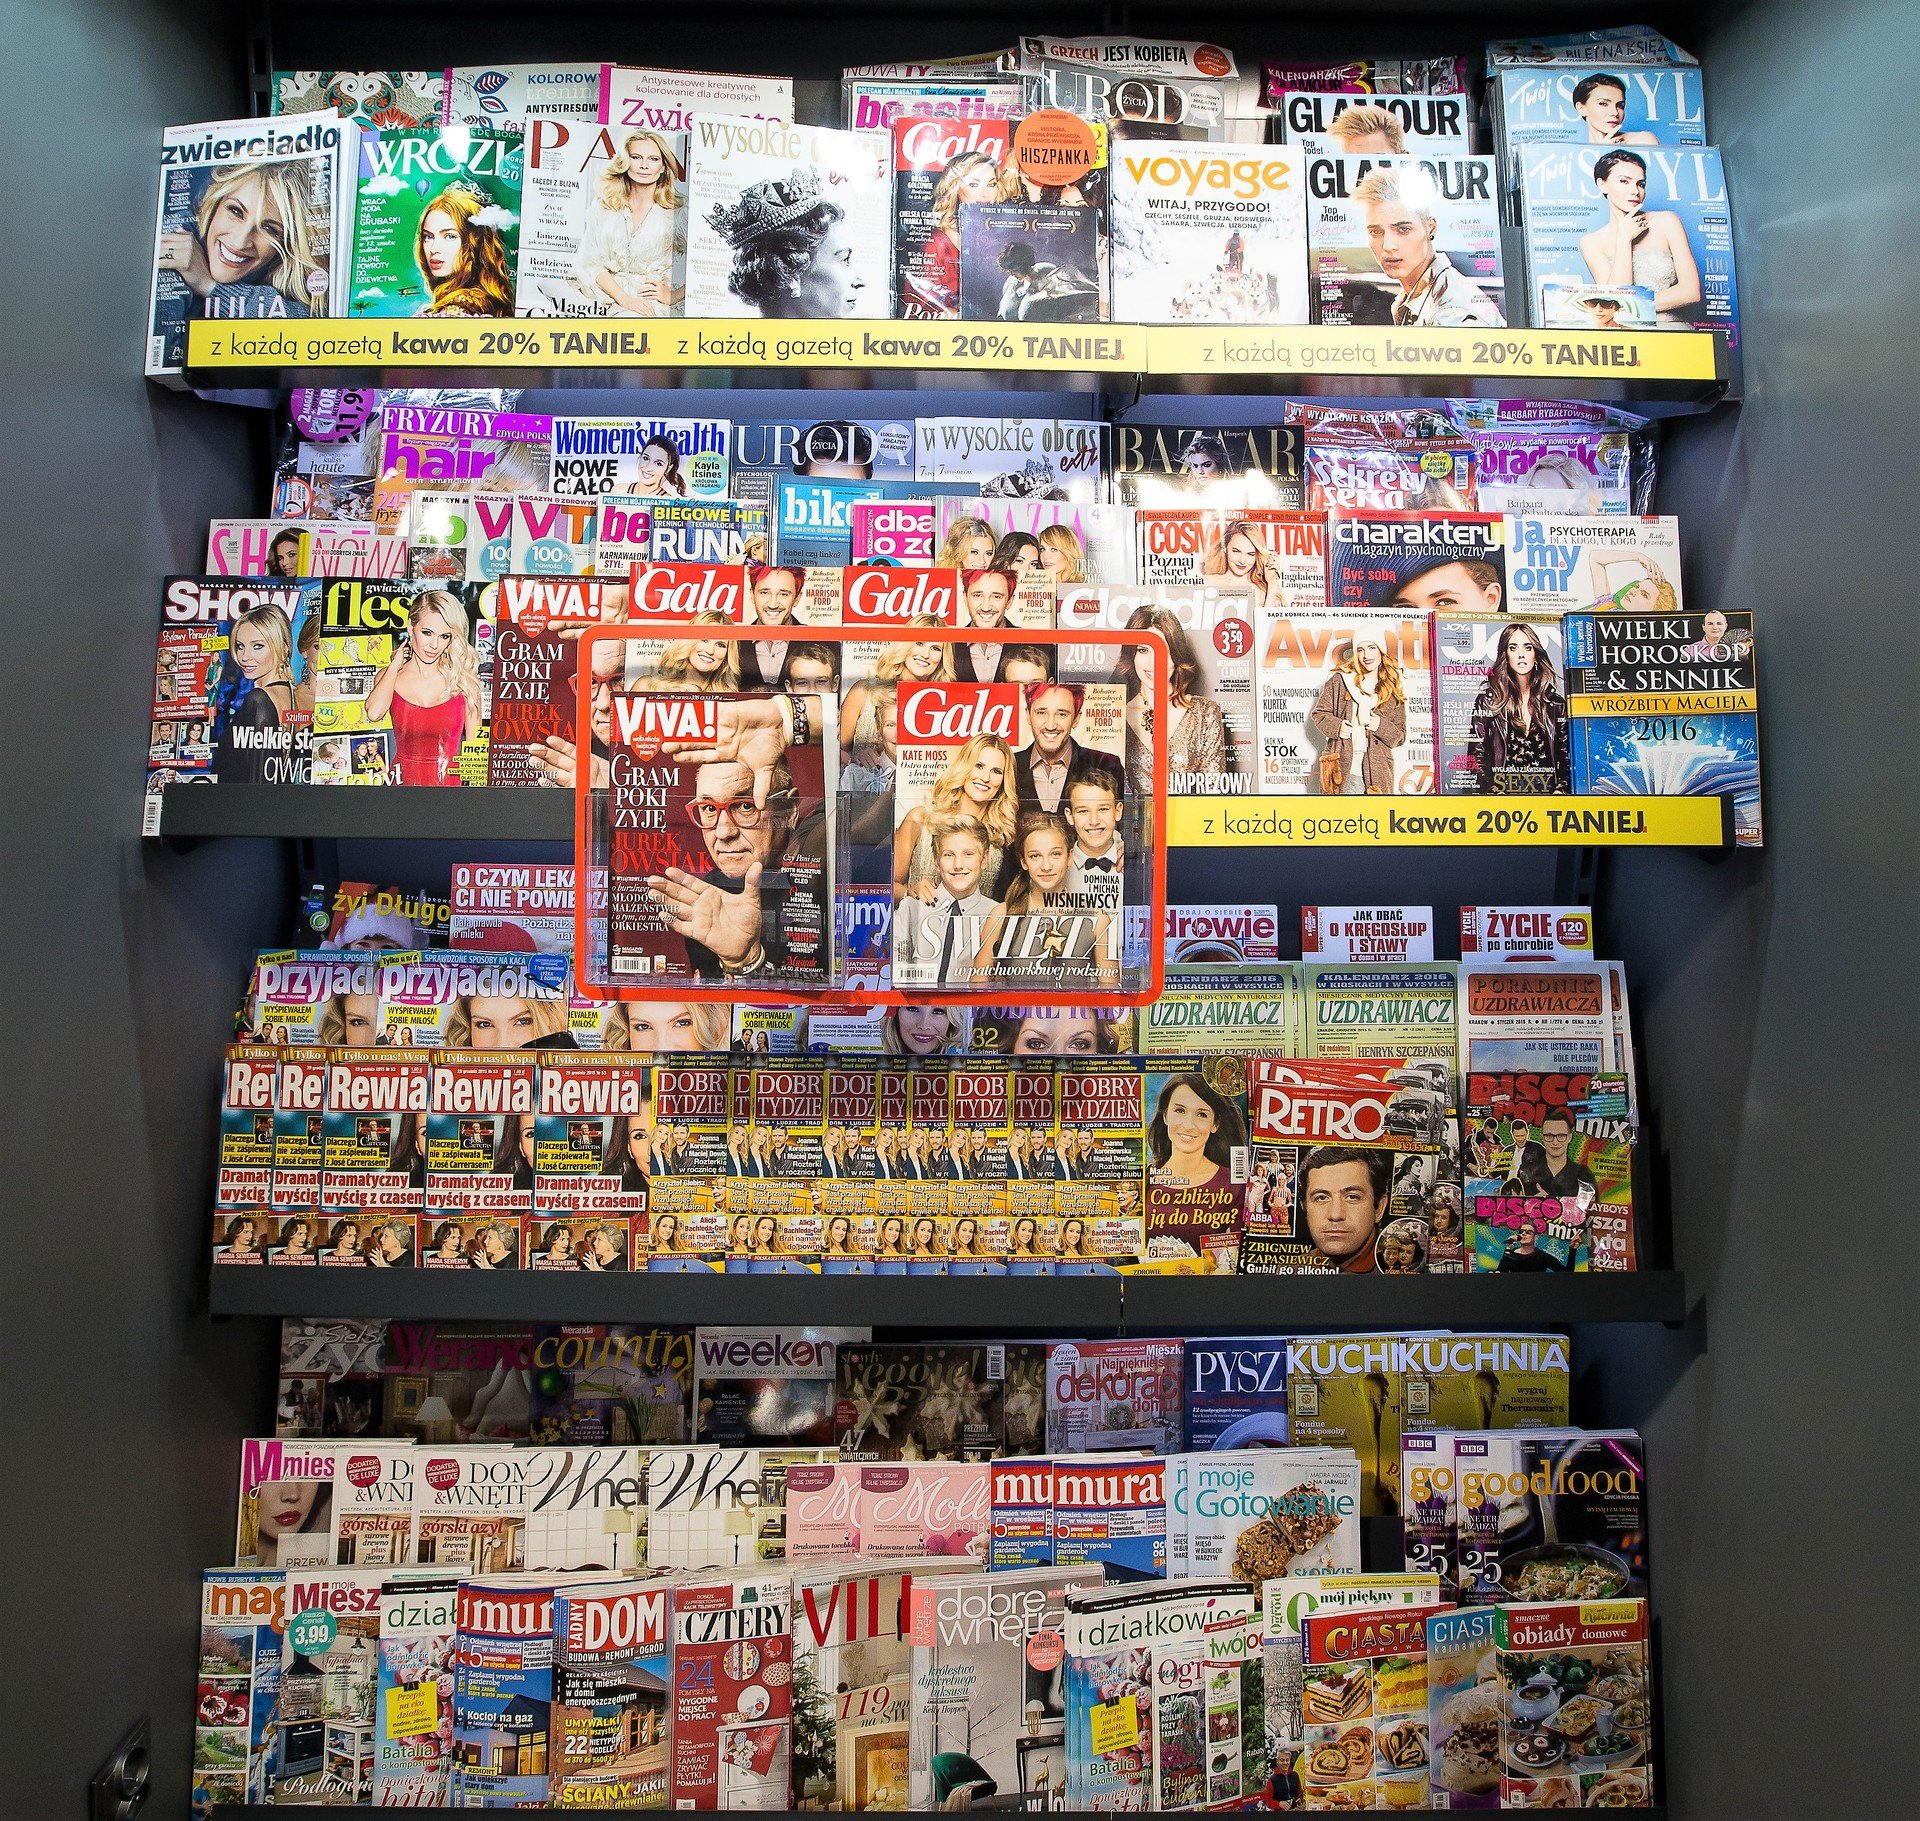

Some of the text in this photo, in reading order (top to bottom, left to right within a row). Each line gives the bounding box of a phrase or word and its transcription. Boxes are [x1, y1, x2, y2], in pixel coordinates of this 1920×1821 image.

[1050, 45, 1188, 64] GRZECH JEST KOBIETĄ
[636, 84, 761, 102] kolorowanie dla dorosłych
[641, 75, 756, 92] Antystresowe kreatywne
[161, 125, 339, 164] zwierciadło
[1021, 147, 1090, 165] HISZPANKA
[1124, 157, 1291, 199] voyage
[1148, 199, 1270, 213] WITAJ, PRZYGODO!
[360, 216, 400, 225] GRUBASKI
[212, 342, 222, 355] z
[231, 333, 297, 359] każdą
[307, 339, 382, 359] gazetą
[392, 333, 468, 354] kawa
[479, 333, 541, 355] 20%
[678, 340, 688, 354] z
[698, 332, 766, 359] każdą
[776, 338, 852, 360] gazetą
[863, 333, 941, 357] kawa
[951, 335, 1014, 358] 20%
[1203, 346, 1213, 361] z
[1224, 339, 1291, 365] każdą
[1301, 345, 1376, 367] gazetą
[1386, 342, 1462, 362] kawa
[1472, 342, 1533, 365] 20%
[383, 407, 498, 436] FRYZURY
[556, 420, 648, 456] Women's
[942, 418, 1034, 459] wysokie
[383, 434, 495, 479] hair
[694, 461, 720, 471] Kayla
[554, 459, 618, 477] NOWE
[692, 469, 722, 479] Itsines
[554, 478, 615, 495] CIAŁO
[654, 507, 730, 522] BIEGOWE
[1336, 522, 1501, 551] charaktery
[1513, 513, 1545, 554] ja
[1550, 526, 1636, 537] PSYCHOTERAPIA
[1353, 543, 1485, 561] magazyn psychologiczny
[1149, 554, 1194, 571] Poznaj
[1149, 575, 1204, 586] uwodzenia
[1151, 566, 1188, 579] sekret
[1343, 567, 1396, 583] Być sobą
[1514, 563, 1569, 592] oni
[634, 567, 738, 617] Gala
[850, 572, 951, 619] Gala
[1344, 584, 1363, 598] czy
[504, 579, 600, 623] VIVA!
[1598, 619, 1690, 640] WIELKI
[1601, 644, 1750, 665] HOROSKOP
[1608, 669, 1747, 691] & SENNIK
[1263, 698, 1288, 711] KURTEK
[1591, 694, 1748, 712] WRÓŻBITY MACIEJA
[615, 697, 717, 746] VIVA!
[903, 688, 1015, 738] Gala
[1086, 708, 1122, 718] HARRISON
[1094, 717, 1113, 727] FORD
[1637, 718, 1697, 742] 2016
[902, 750, 947, 761] KATE MOSS
[1265, 745, 1297, 757] STOK
[611, 754, 680, 787] GRAM
[615, 784, 668, 806] PÓKI
[614, 808, 667, 832] ŻYJĘ
[1204, 819, 1214, 833] z
[1224, 809, 1293, 839] każdą
[1303, 816, 1379, 839] gazetą
[1389, 809, 1466, 834] kawa
[1477, 811, 1538, 833] 20%
[1084, 874, 1120, 884] DOMINIKA
[1089, 884, 1119, 892] i MICHAŁ
[332, 891, 450, 925] żyj Długo
[1043, 888, 1119, 909] WIŚNIEWSCY
[1353, 908, 1403, 921] JAK DBAĆ
[1487, 910, 1552, 938] ŻYCIE
[612, 922, 669, 932] ORKIESTRA
[1330, 921, 1426, 940] O KRĘGOSŁUP
[1561, 921, 1583, 932] 120
[1349, 939, 1407, 953] I STAWY
[1488, 939, 1554, 952] po chorobie
[954, 961, 1118, 981] w patchworkowej rodzinie
[1473, 978, 1595, 994] PORADNIK
[263, 1005, 312, 1015] WYŚPIEWAŁEM
[1318, 1000, 1450, 1025] UZDRAWIACZ
[1473, 997, 1600, 1011] UZDRAWIACZA
[265, 1014, 309, 1024] SOBIE MIŁOŚĆ
[540, 1070, 639, 1114] Rewia
[1063, 1077, 1139, 1097] DOBRY
[1062, 1097, 1141, 1120] TYDZIEŃ
[1259, 1088, 1384, 1141] RETRO
[538, 1141, 568, 1151] Dlaczego
[537, 1176, 620, 1192] Dramatyczny
[536, 1194, 642, 1209] wyścig z czasem!
[1150, 1189, 1233, 1208] Co zbliżyło
[1148, 1207, 1238, 1230] ją do Boga?
[1250, 1214, 1273, 1223] ABBA
[1248, 1241, 1312, 1254] ZBIGNIEW
[1247, 1253, 1330, 1266] ZAPASIEWICZ
[1400, 1343, 1570, 1372] KUCHNIA
[1200, 1467, 1254, 1487] moje
[1196, 1491, 1355, 1517] Gotowanie
[422, 1519, 503, 1538] górski azyl
[937, 1586, 1046, 1621] dobre
[1320, 1589, 1394, 1605] mój piękny
[569, 1602, 584, 1650] ŁADNY
[585, 1592, 666, 1650] DOM
[685, 1604, 790, 1644] CZTERY
[295, 1625, 329, 1645] 3,99
[1325, 1617, 1425, 1659] CIASTA
[1513, 1623, 1627, 1644] obiady domowe
[569, 1643, 664, 1663] BUDOWA REMONT OGRÓD
[679, 1661, 714, 1689] 24
[679, 1696, 718, 1705] WYGODNE
[679, 1704, 707, 1714] MIEJSCE
[691, 1711, 716, 1721] PRACY
[383, 1744, 433, 1760] Batalia
[563, 1781, 631, 1802] ŚCIANY
